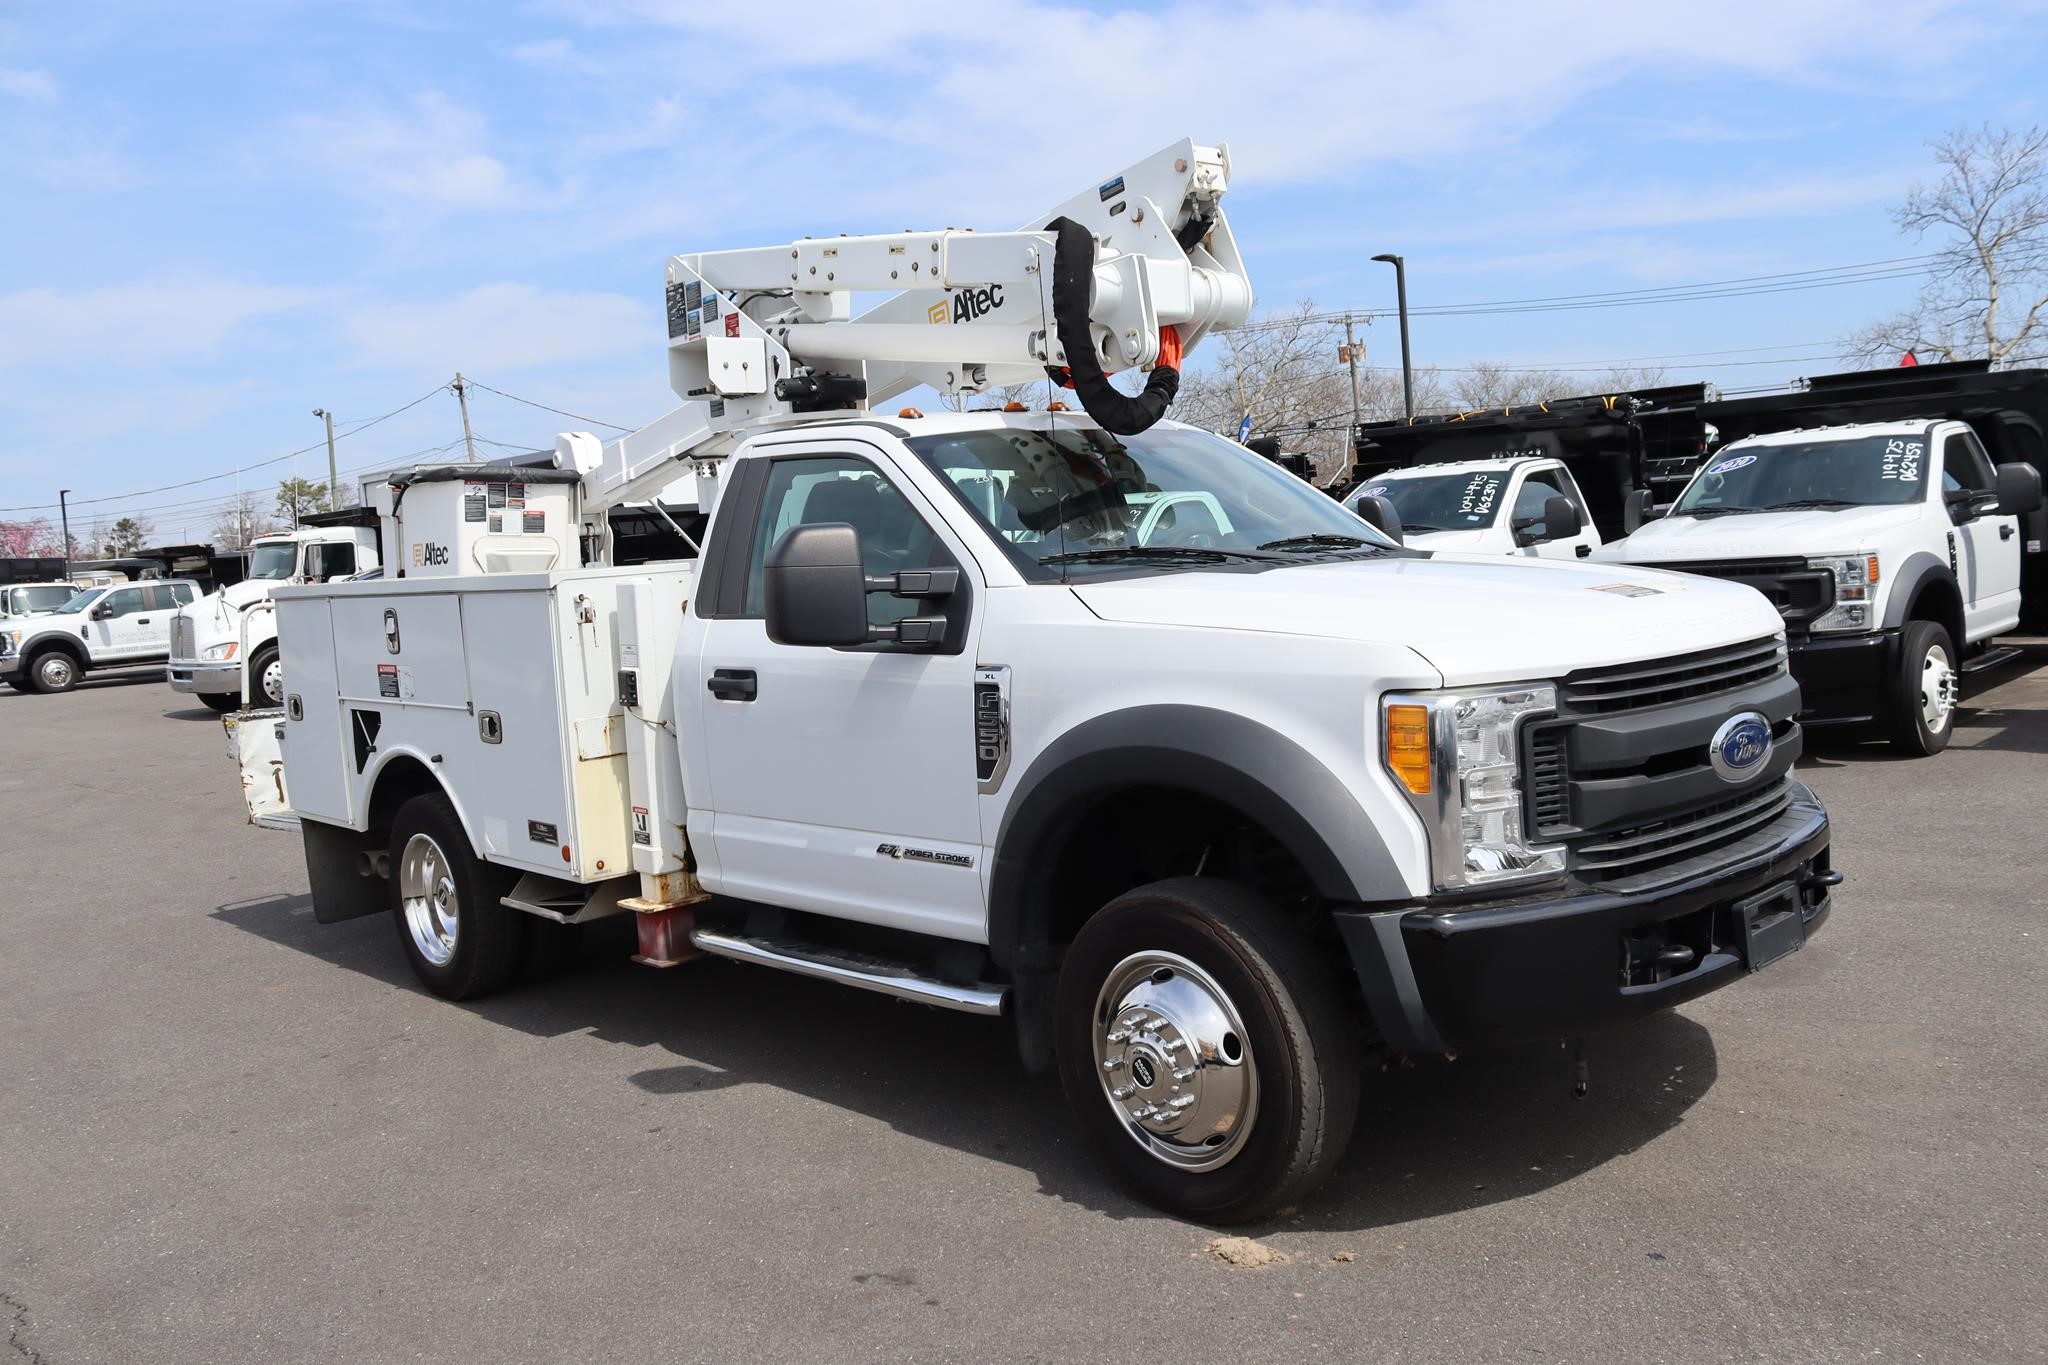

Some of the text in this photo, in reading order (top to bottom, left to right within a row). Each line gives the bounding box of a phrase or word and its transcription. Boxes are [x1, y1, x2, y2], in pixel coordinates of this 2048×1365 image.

[954, 284, 1004, 324] Altec
[424, 542, 449, 566] Altec
[1727, 731, 1762, 762] Ford
[904, 848, 933, 859] POWER
[935, 852, 970, 864] STROKE
